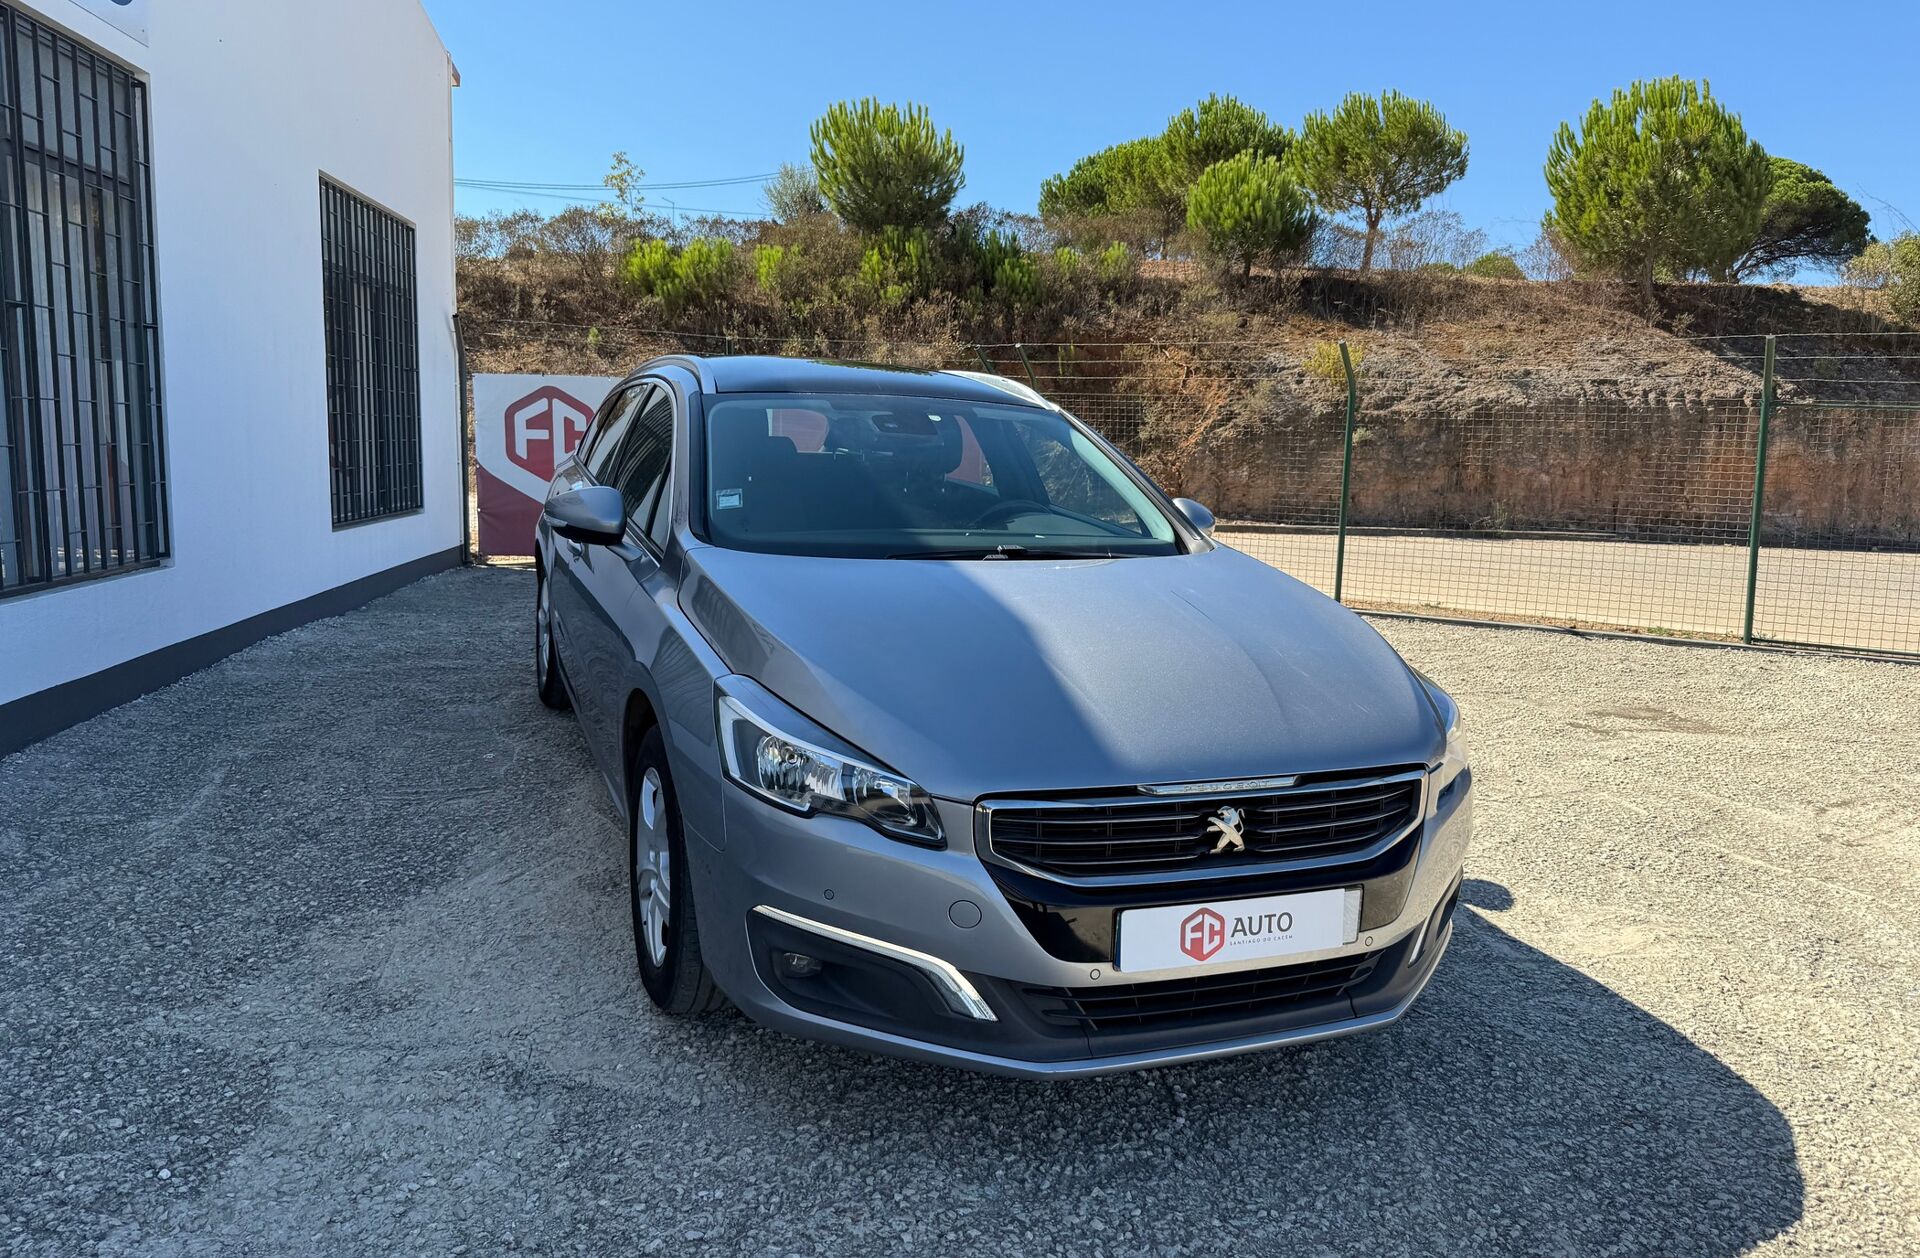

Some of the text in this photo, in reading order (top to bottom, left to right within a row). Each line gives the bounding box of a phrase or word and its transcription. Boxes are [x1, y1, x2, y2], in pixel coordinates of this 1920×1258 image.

[1183, 780, 1270, 792] PEUGEOT
[1230, 911, 1293, 938] AUTO
[1230, 938, 1261, 946] SANTIAGO
